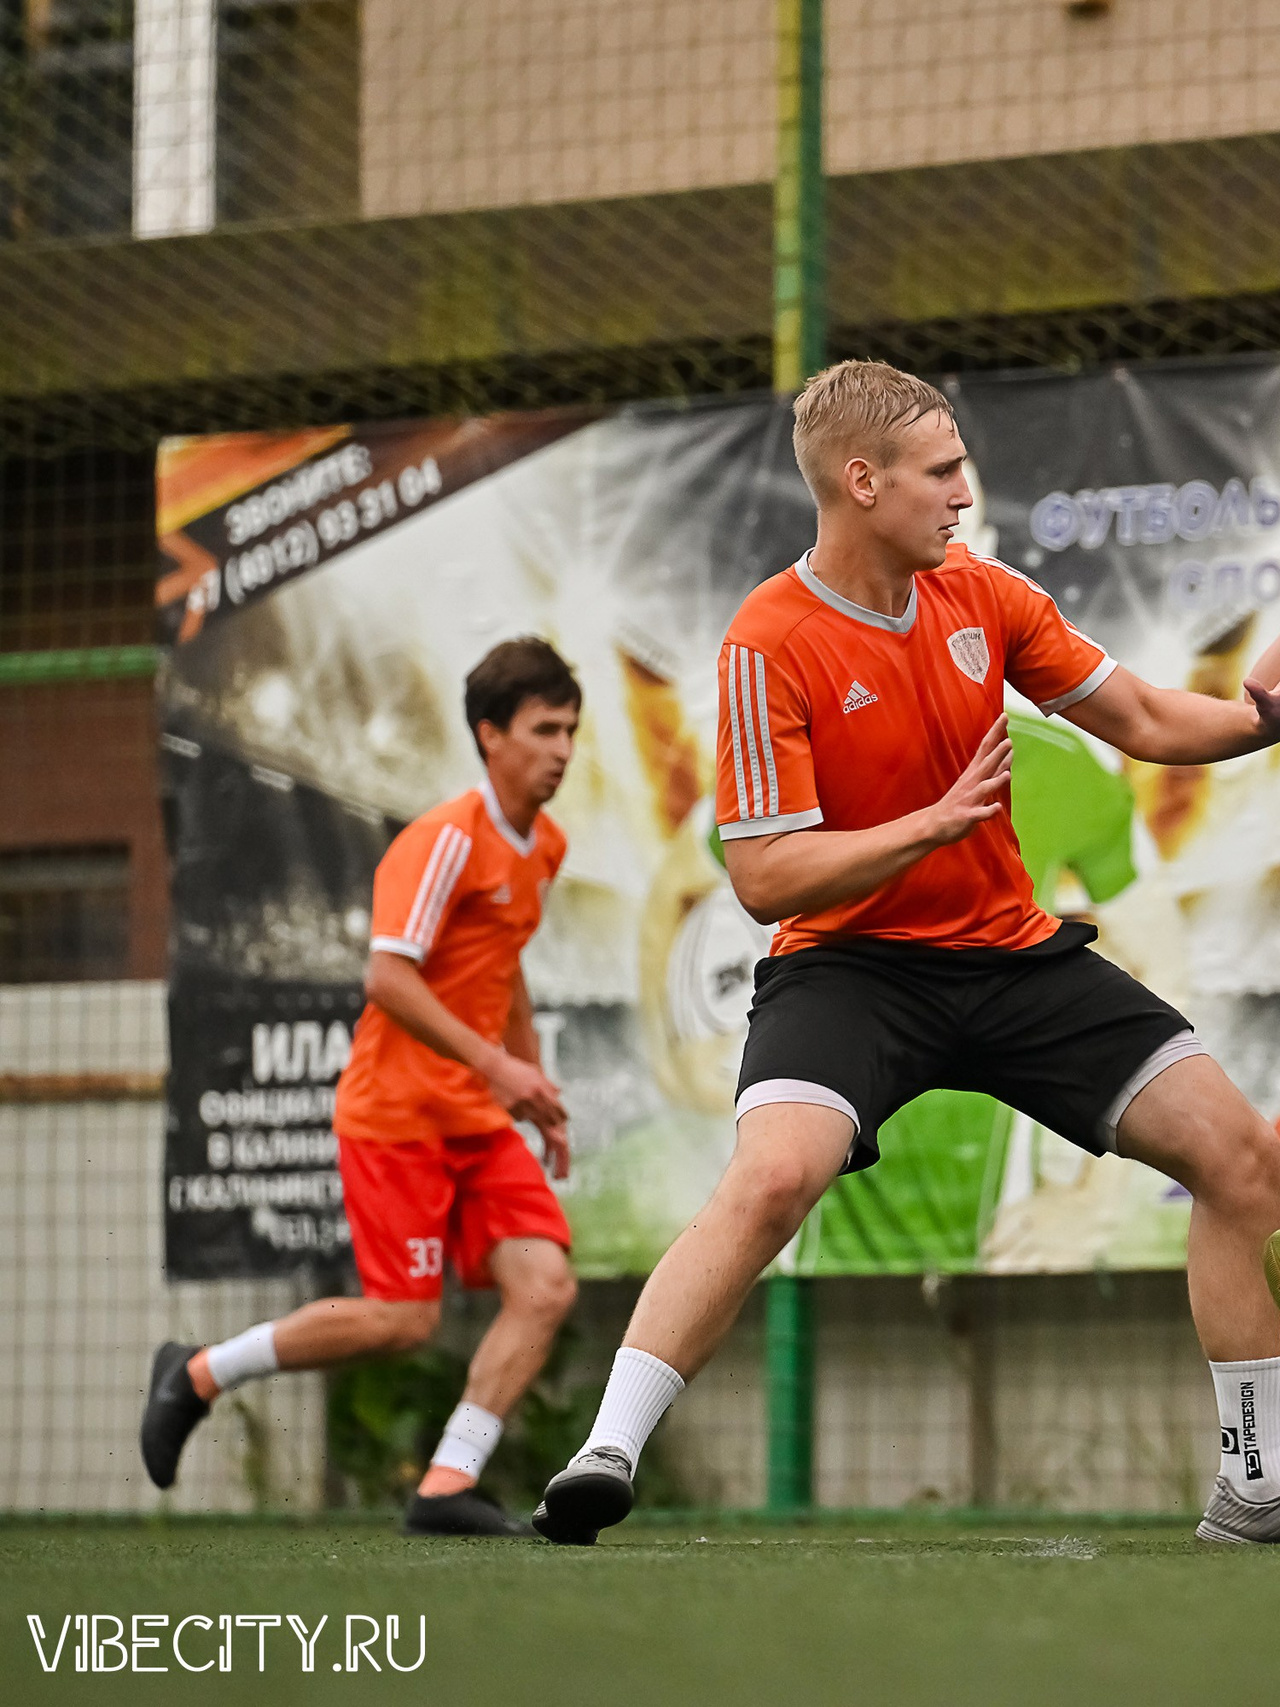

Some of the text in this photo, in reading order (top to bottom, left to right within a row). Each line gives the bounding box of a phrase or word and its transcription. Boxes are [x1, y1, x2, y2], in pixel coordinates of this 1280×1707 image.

[842, 693, 879, 714] adidas
[406, 1237, 443, 1277] 33
[1240, 1381, 1257, 1450] TAPEDESIGN
